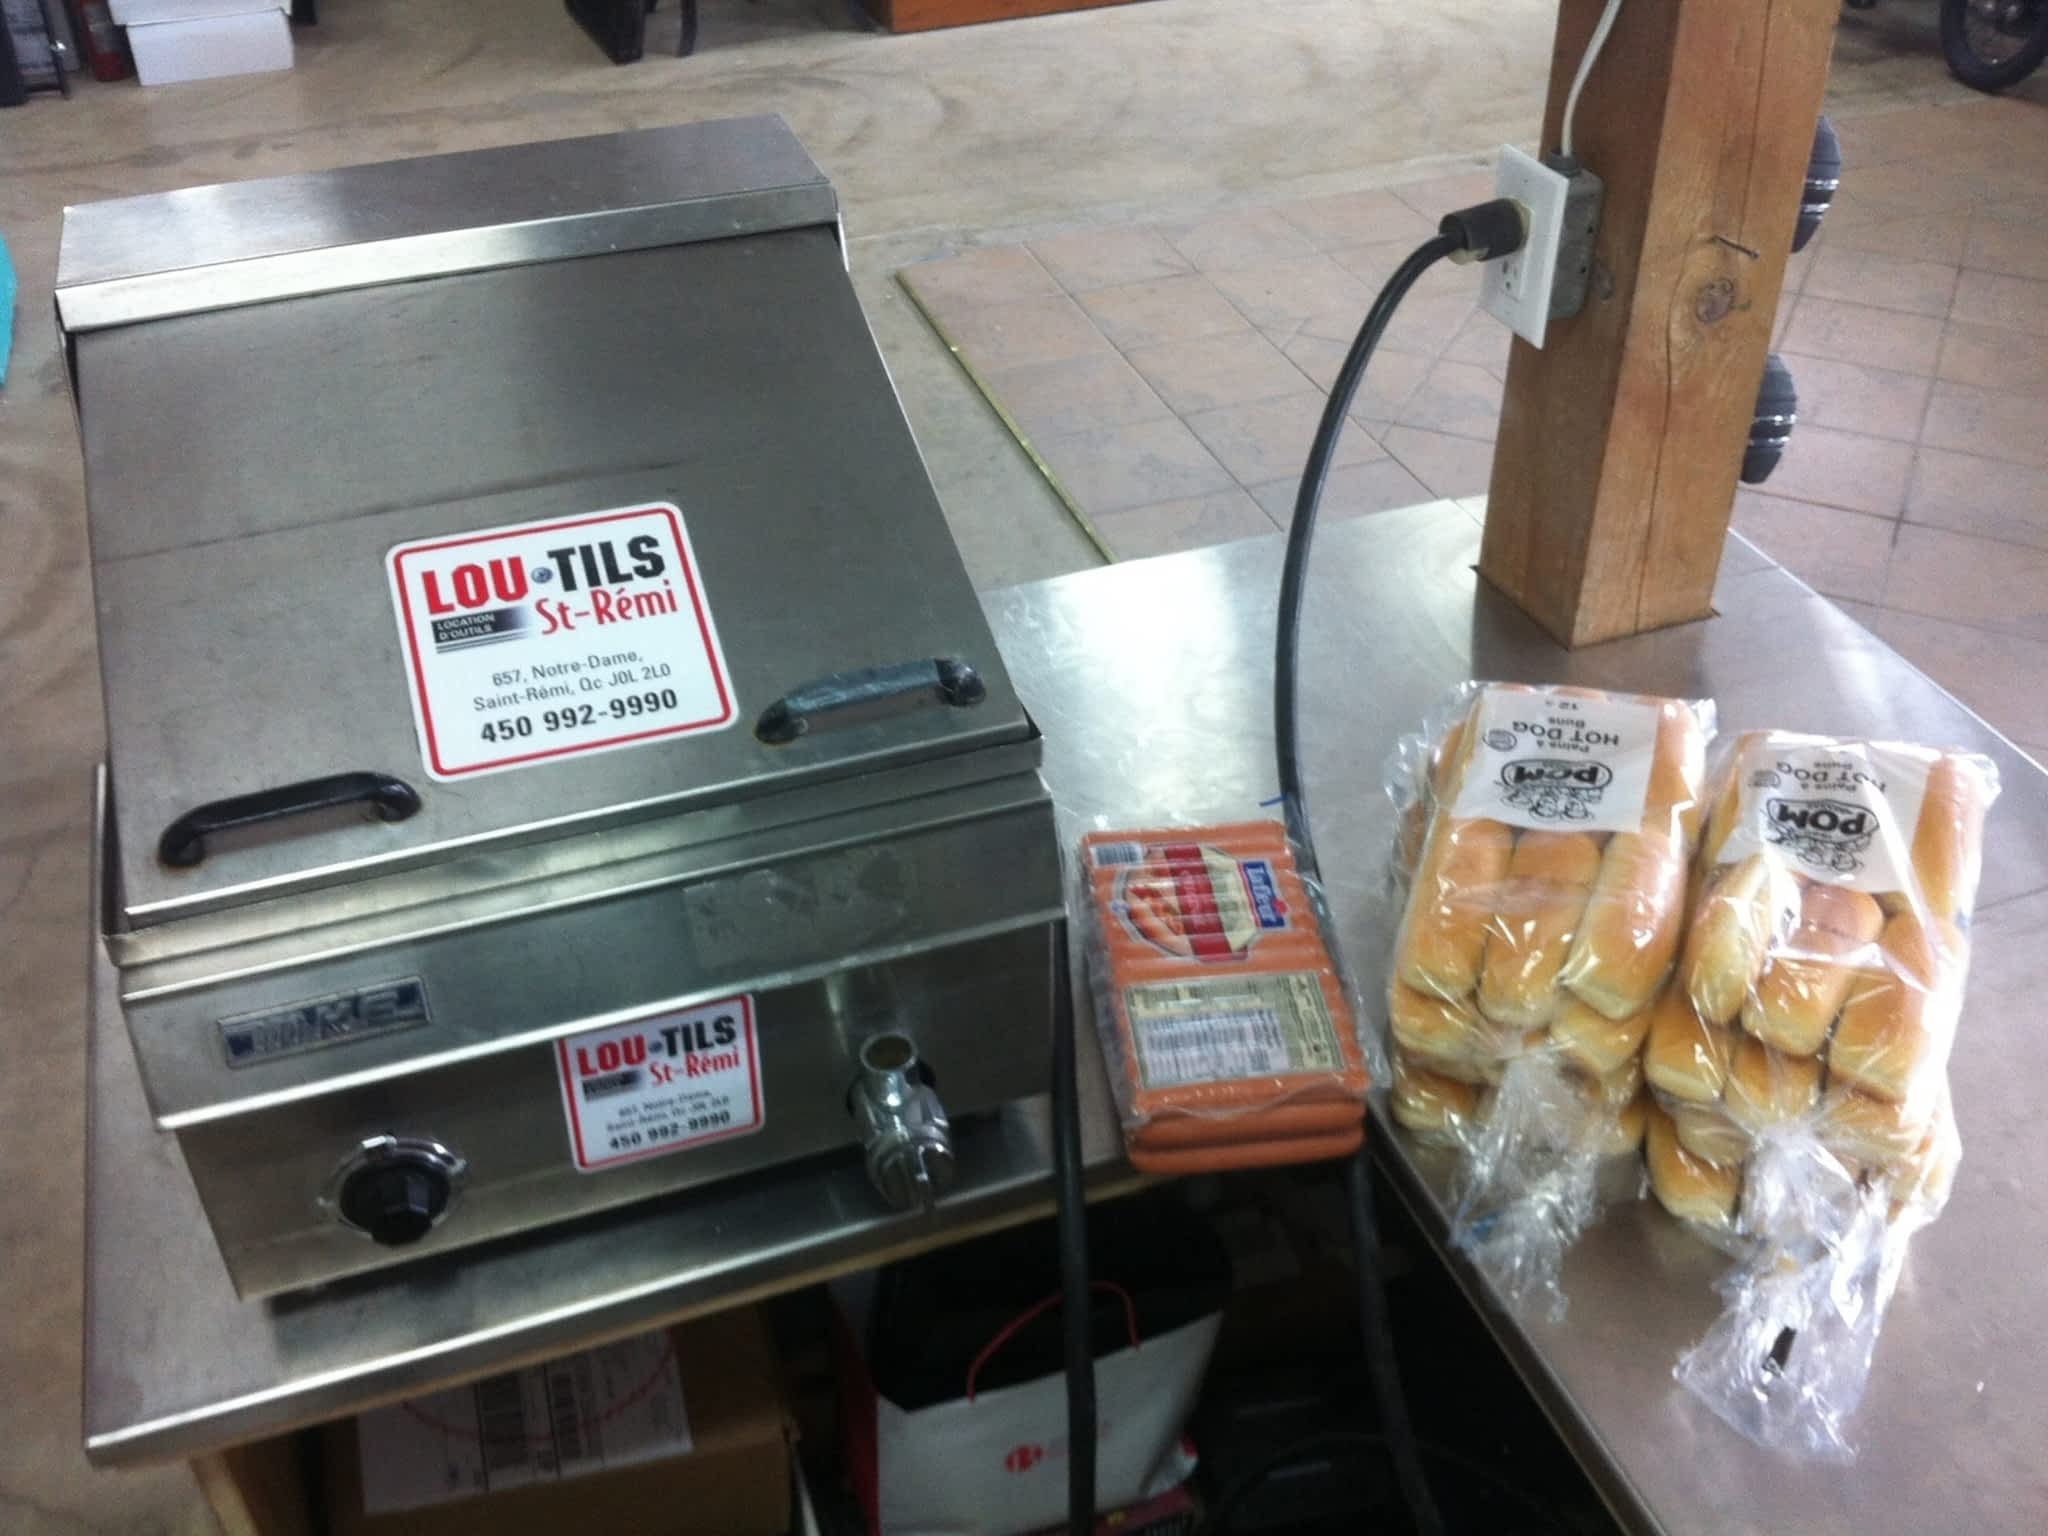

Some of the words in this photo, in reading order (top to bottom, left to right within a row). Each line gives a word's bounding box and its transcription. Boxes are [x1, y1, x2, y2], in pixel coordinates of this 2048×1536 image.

[422, 557, 529, 615] LOU
[547, 535, 665, 592] TILS
[535, 579, 678, 635] St-Rémi
[437, 612, 496, 633] LOCATION
[579, 676, 602, 694] Qc
[480, 716, 532, 743] 450
[543, 689, 678, 732] 992-9990
[1512, 720, 1563, 741] DOG
[1567, 730, 1620, 746] HOT
[1513, 765, 1599, 785] POM
[1776, 761, 1829, 782] DOG
[1776, 803, 1868, 836] POM
[576, 1034, 646, 1076] LOU
[660, 1015, 736, 1057] TILS
[649, 1045, 741, 1088] St-Rémi
